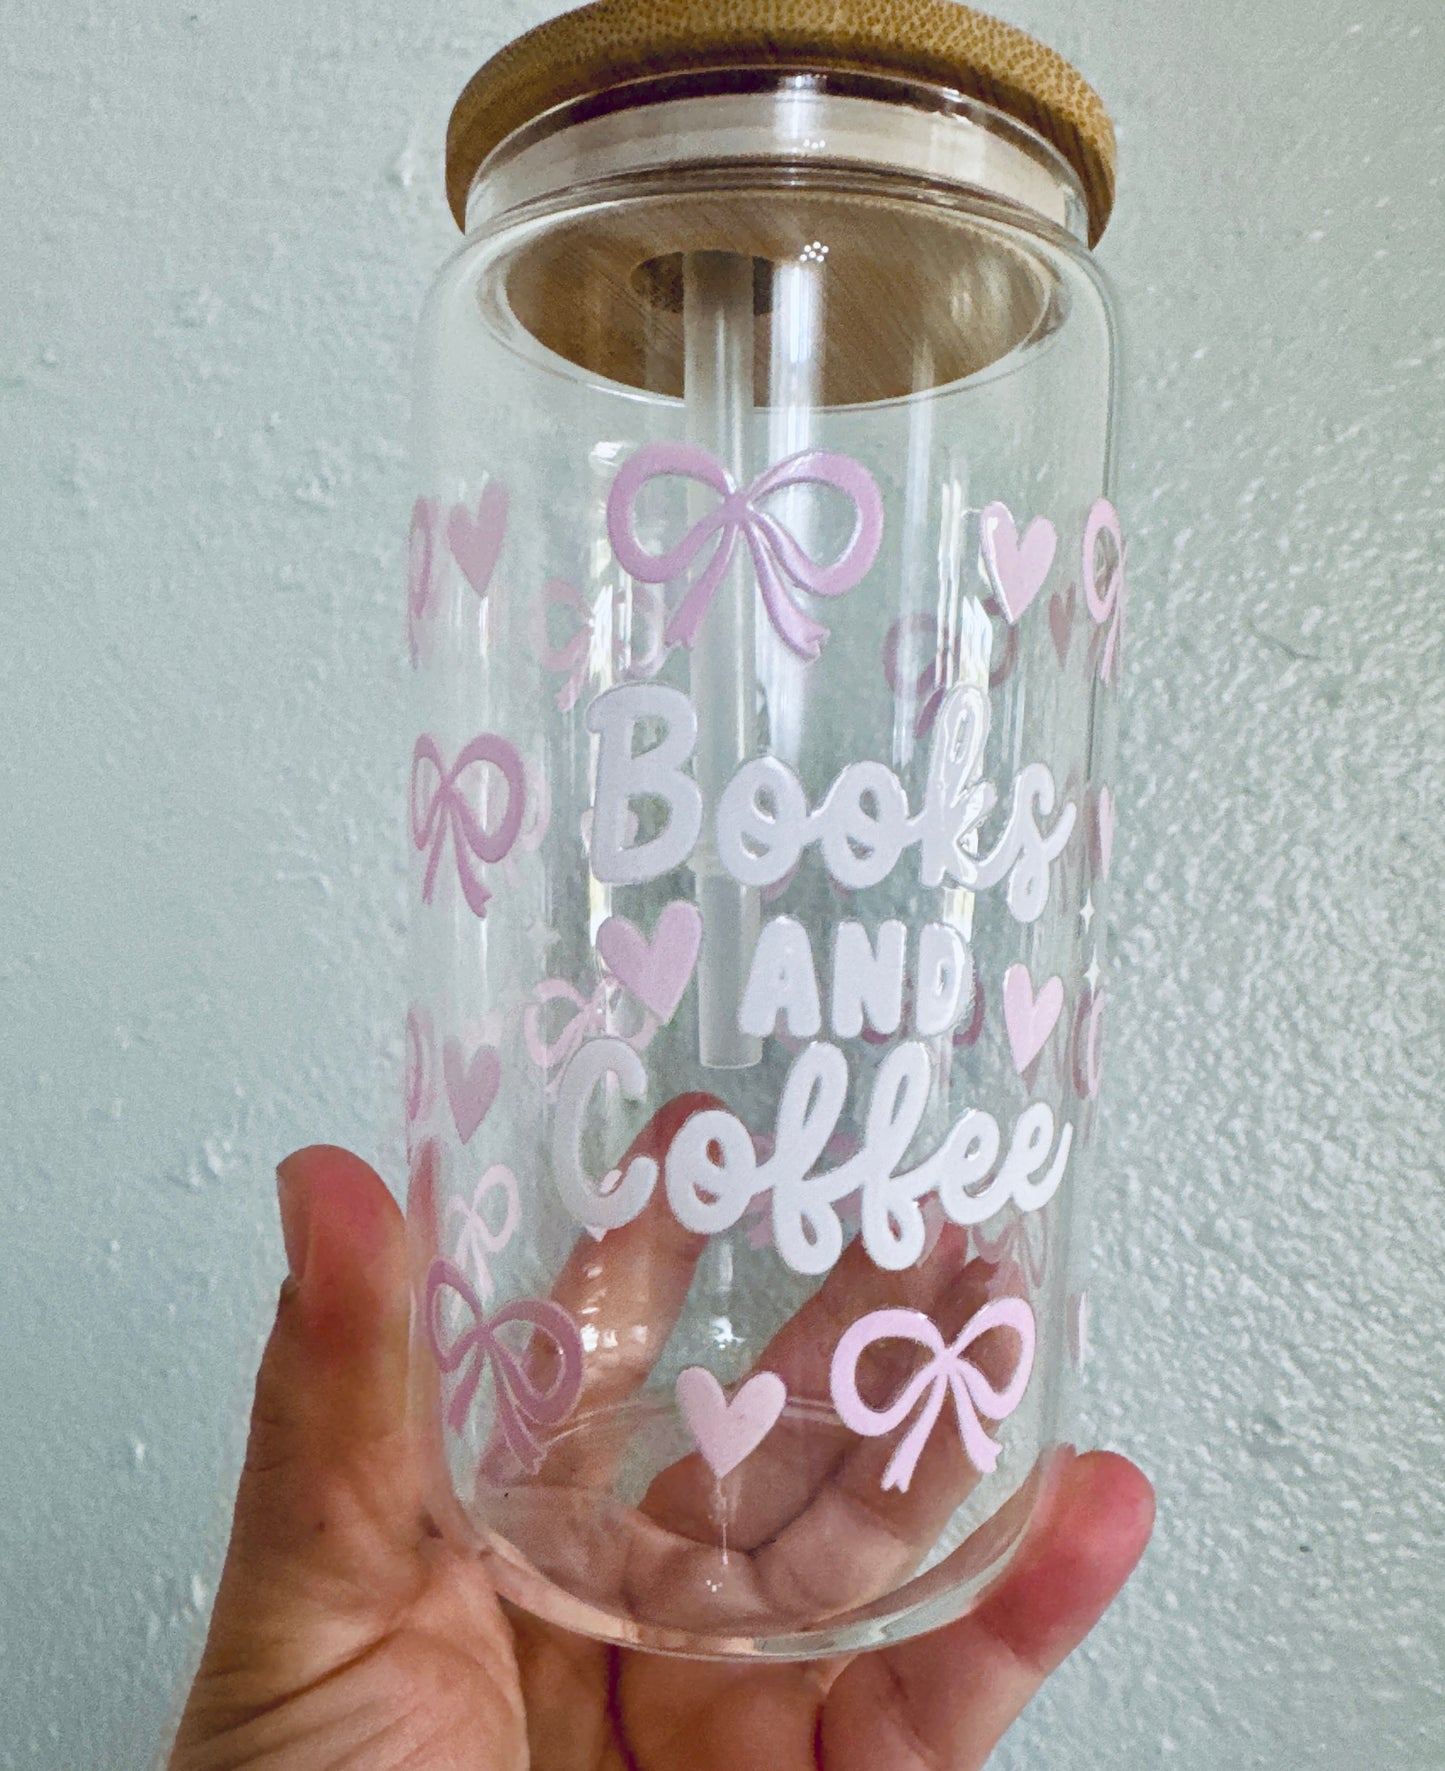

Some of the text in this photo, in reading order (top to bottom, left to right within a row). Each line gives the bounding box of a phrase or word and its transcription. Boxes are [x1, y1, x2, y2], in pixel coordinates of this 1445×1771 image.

[587, 684, 1077, 924] Books
[738, 915, 976, 1039] AND
[555, 1037, 1074, 1276] Coffee
